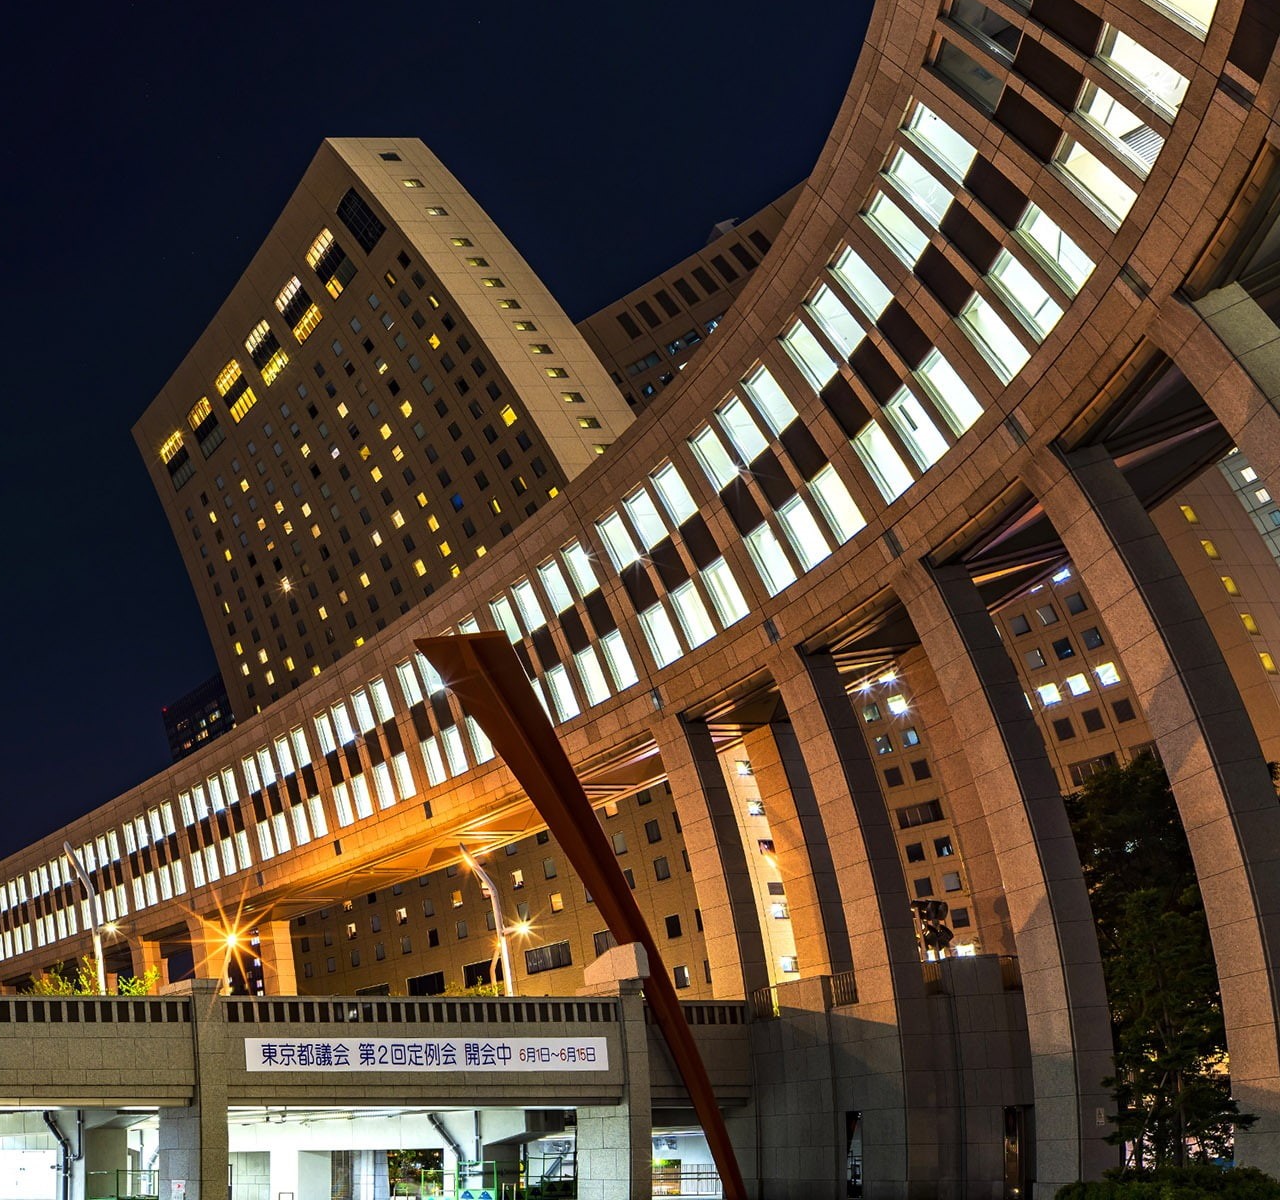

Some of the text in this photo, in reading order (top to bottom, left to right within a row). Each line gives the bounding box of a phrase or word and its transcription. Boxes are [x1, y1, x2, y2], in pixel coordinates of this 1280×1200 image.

[261, 1043, 350, 1066] 東京都議会
[358, 1043, 457, 1066] 第2回定例会
[464, 1043, 512, 1066] 開会中
